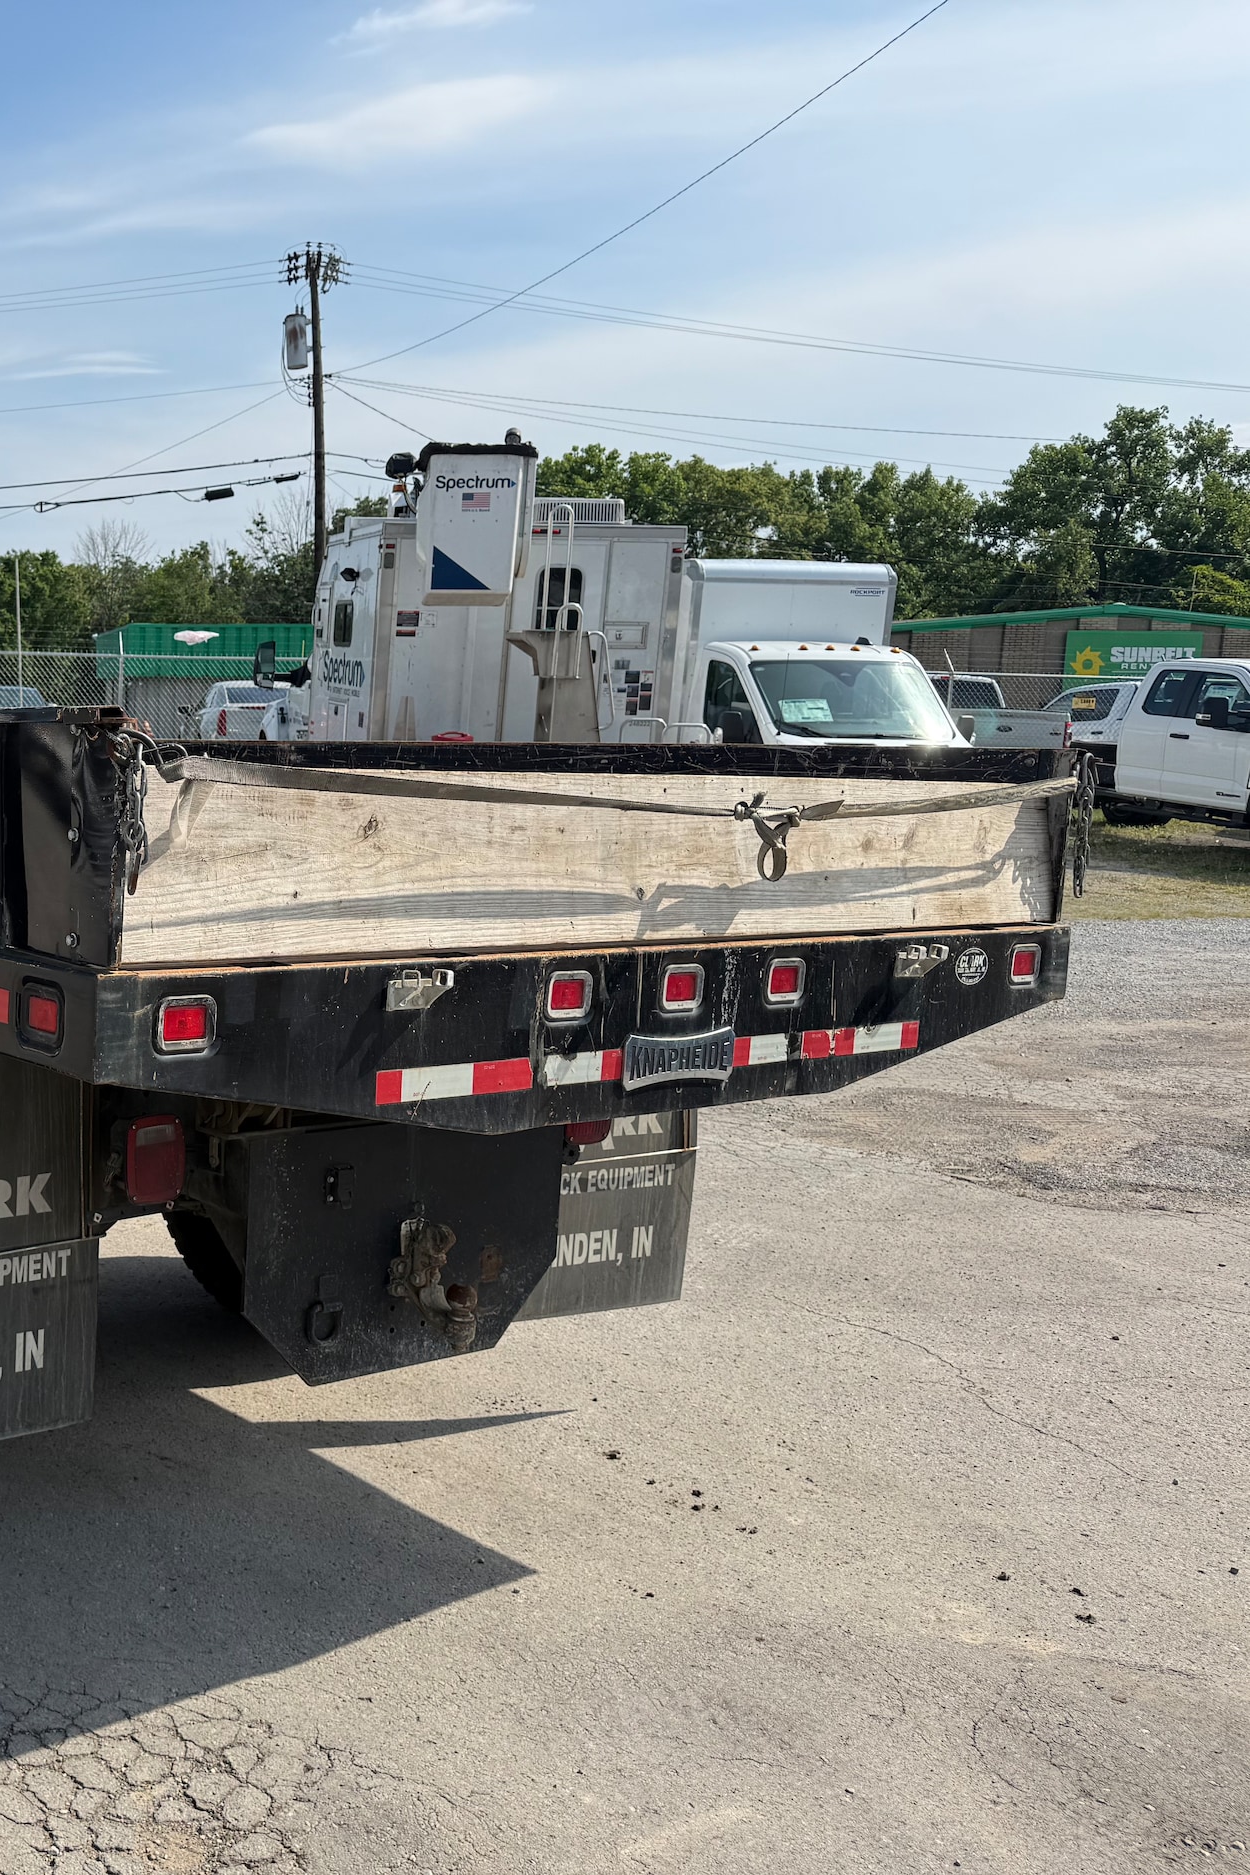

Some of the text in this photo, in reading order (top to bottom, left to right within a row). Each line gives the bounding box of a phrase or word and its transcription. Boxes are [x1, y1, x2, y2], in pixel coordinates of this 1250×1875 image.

[435, 475, 511, 492] Spectrum
[323, 649, 362, 691] Spectrum
[1110, 646, 1196, 663] SUNBELT
[629, 1037, 731, 1083] KNAPHEIDE
[587, 1163, 676, 1193] EQUIPMENT
[630, 1225, 654, 1259] IN
[15, 1328, 45, 1373] IN
